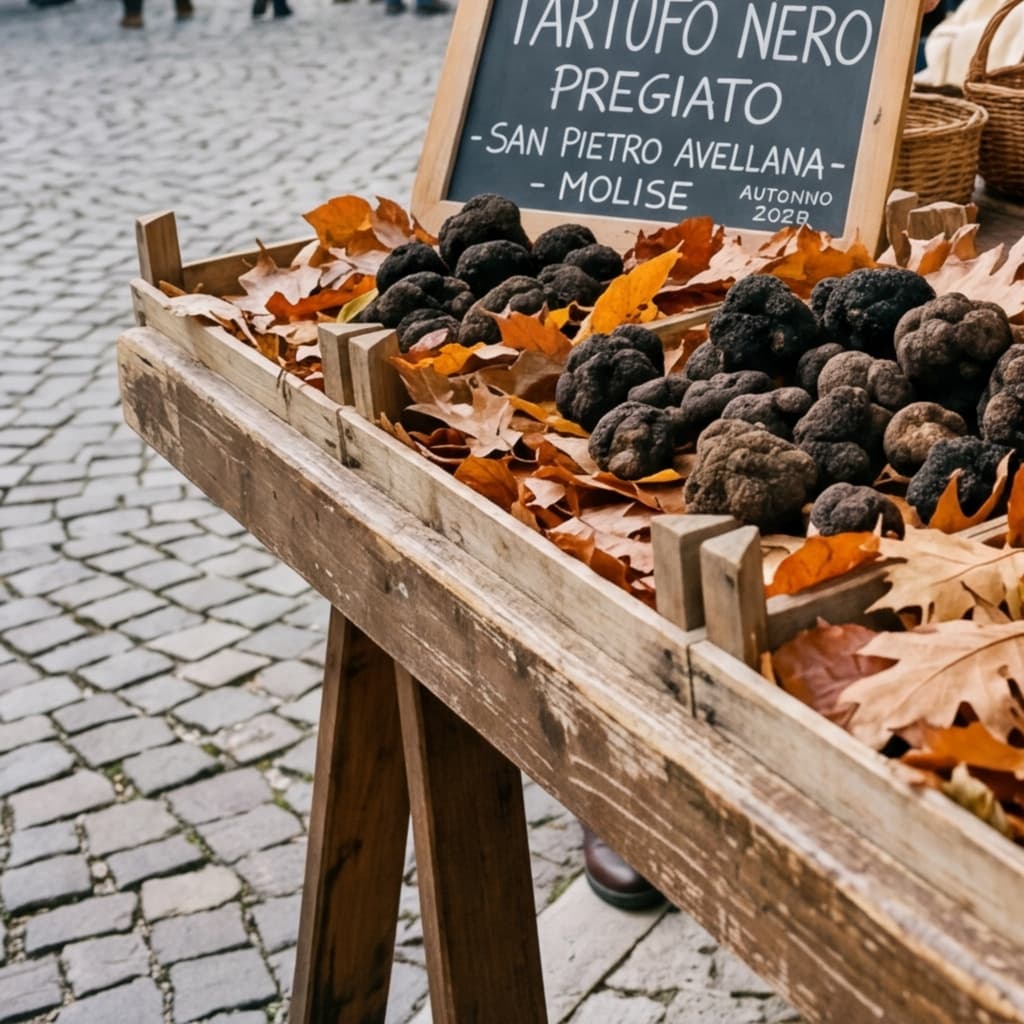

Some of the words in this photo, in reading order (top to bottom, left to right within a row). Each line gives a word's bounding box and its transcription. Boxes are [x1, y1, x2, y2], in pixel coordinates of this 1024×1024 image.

[550, 63, 783, 126] PREGIATO
[560, 126, 663, 167] PIETRO
[558, 171, 694, 211] MOLISE
